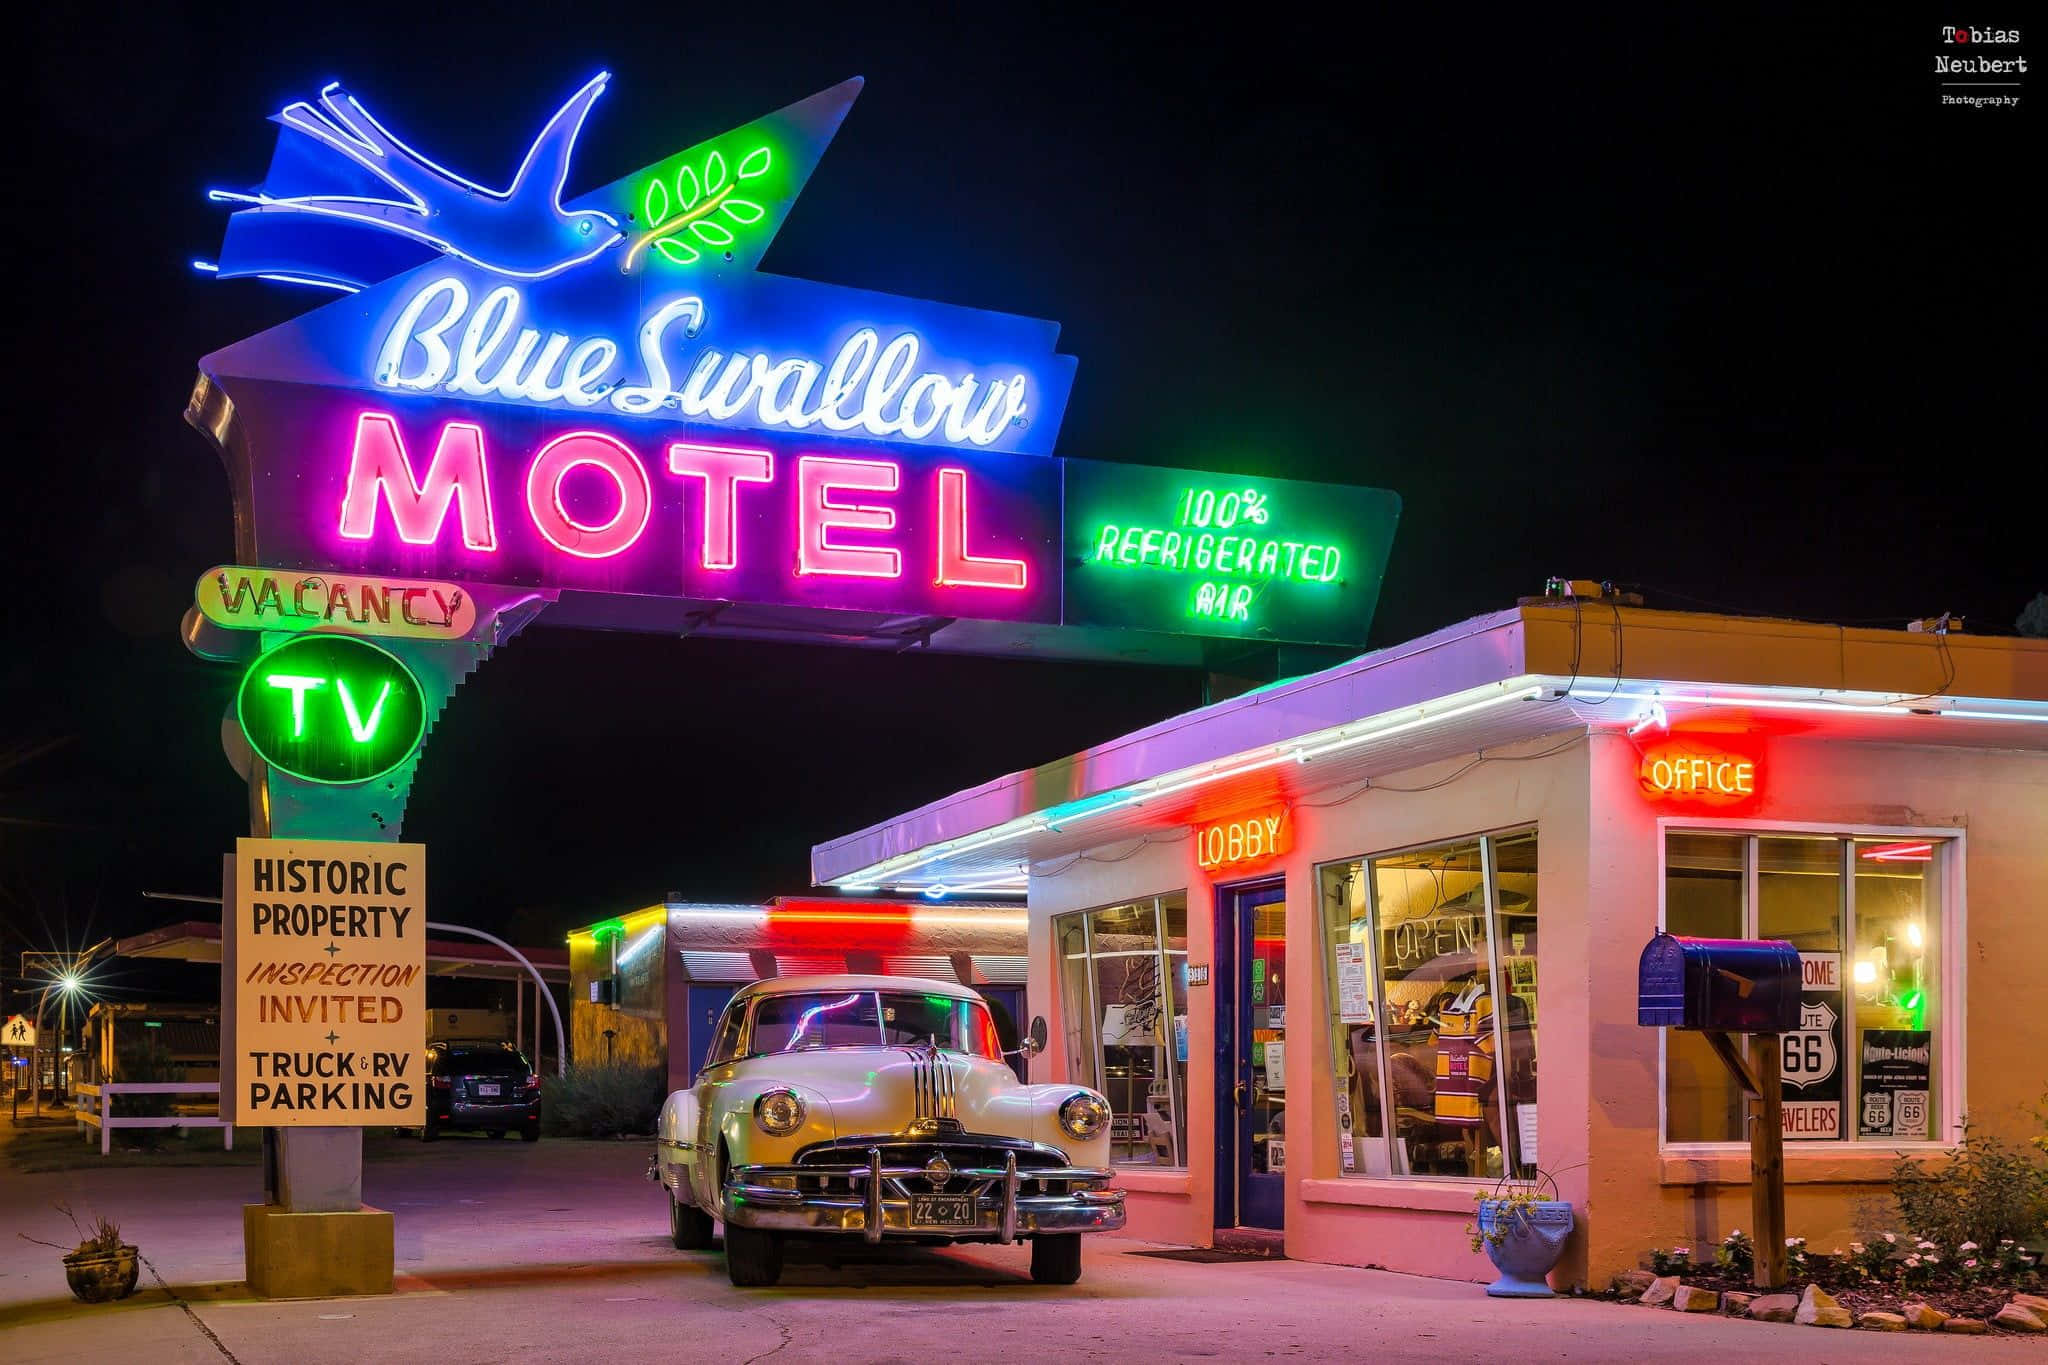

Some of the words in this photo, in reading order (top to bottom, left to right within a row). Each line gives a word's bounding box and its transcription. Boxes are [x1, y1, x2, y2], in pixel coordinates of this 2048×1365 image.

[374, 276, 618, 403] Blue
[609, 296, 1030, 446] Swallow
[338, 411, 1030, 591] MOTEL
[1181, 487, 1270, 528] 100%
[1094, 524, 1343, 584] REFRIGERATED
[217, 573, 463, 628] VACANCY
[1193, 581, 1253, 621] AIR
[265, 673, 392, 743] TV
[1652, 758, 1754, 793] OFFICE
[1197, 816, 1281, 866] LOBBY
[253, 858, 408, 896] HISTORIC
[252, 903, 412, 938] PROPERTY
[1394, 912, 1474, 960] OPEN
[245, 962, 420, 987] INSPECTION
[259, 995, 403, 1024] INVITED
[1800, 1014, 1823, 1027] UTE
[249, 1052, 355, 1078] TRUCK
[360, 1056, 369, 1071] &
[372, 1053, 410, 1077] RV
[1783, 1034, 1823, 1073] 66
[250, 1082, 413, 1110] PARKING
[1904, 1105, 1921, 1119] 66
[1781, 1107, 1836, 1133] AVELERS
[1869, 1110, 1885, 1124] 66
[916, 1203, 932, 1219] 22
[953, 1203, 969, 1219] 20
